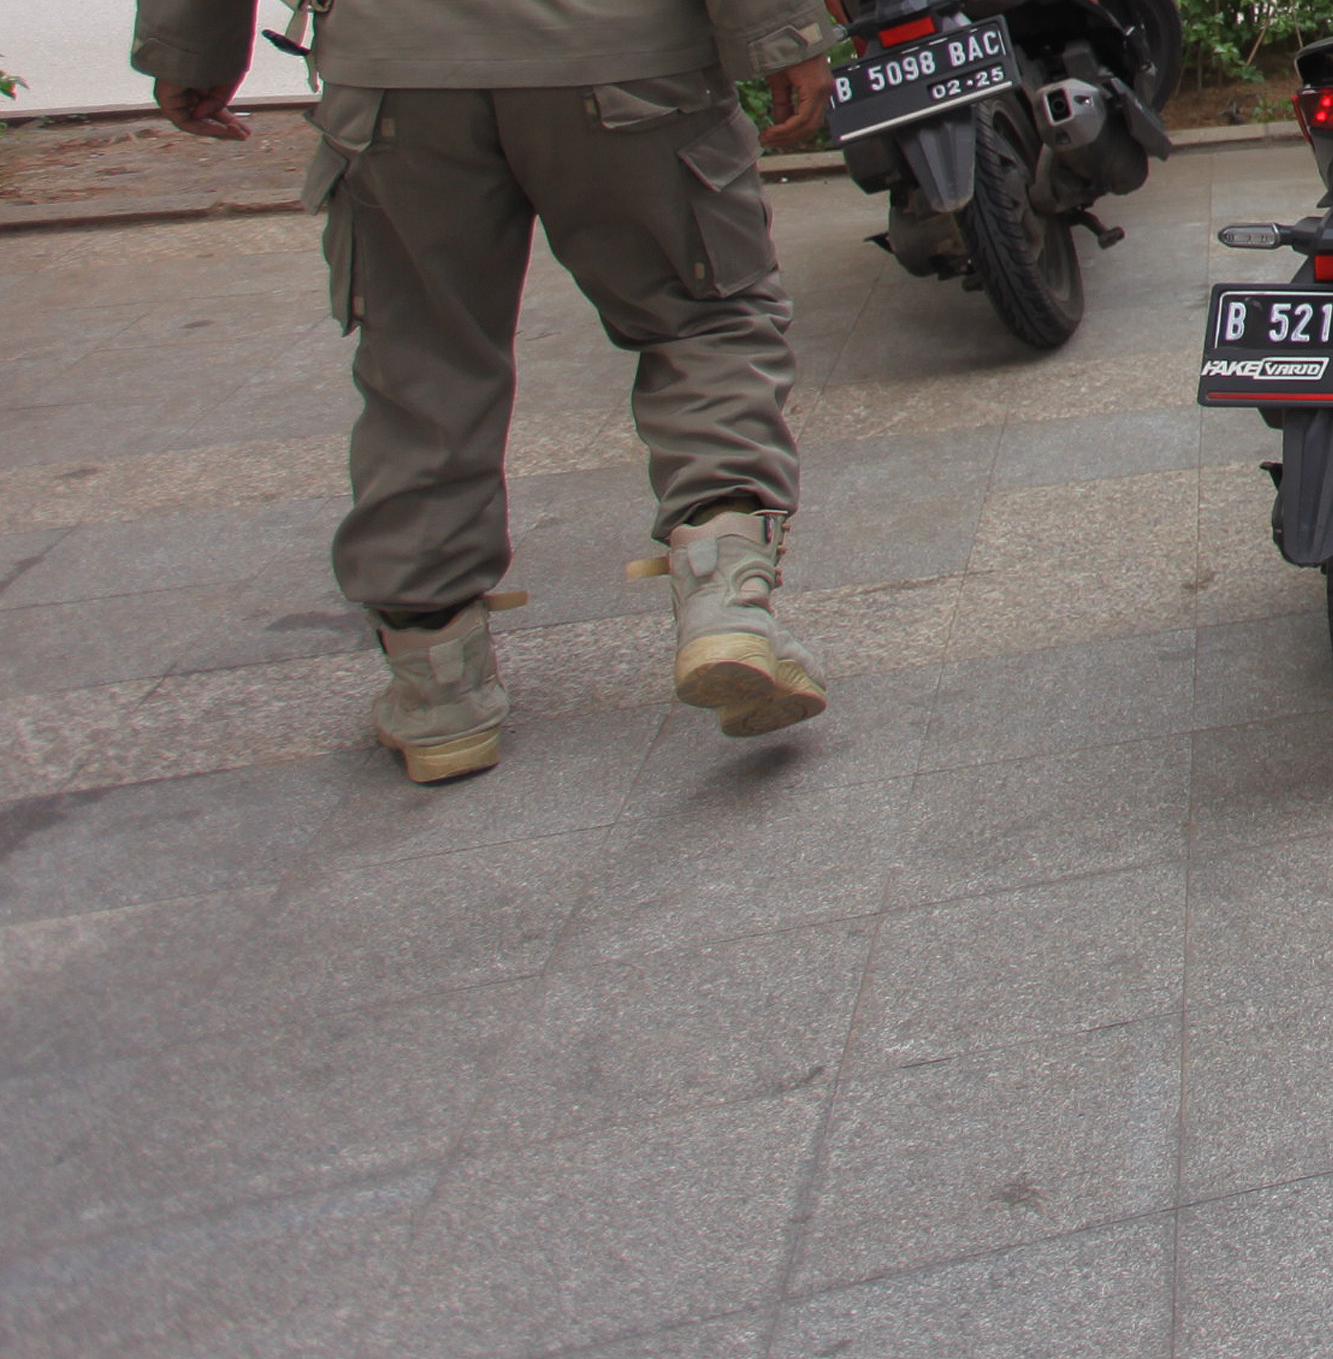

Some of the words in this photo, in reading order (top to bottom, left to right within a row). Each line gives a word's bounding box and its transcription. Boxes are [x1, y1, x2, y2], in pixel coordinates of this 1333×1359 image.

[835, 76, 853, 103] B
[867, 50, 936, 91] 5098
[947, 30, 1001, 67] BAC
[1225, 301, 1247, 341] B
